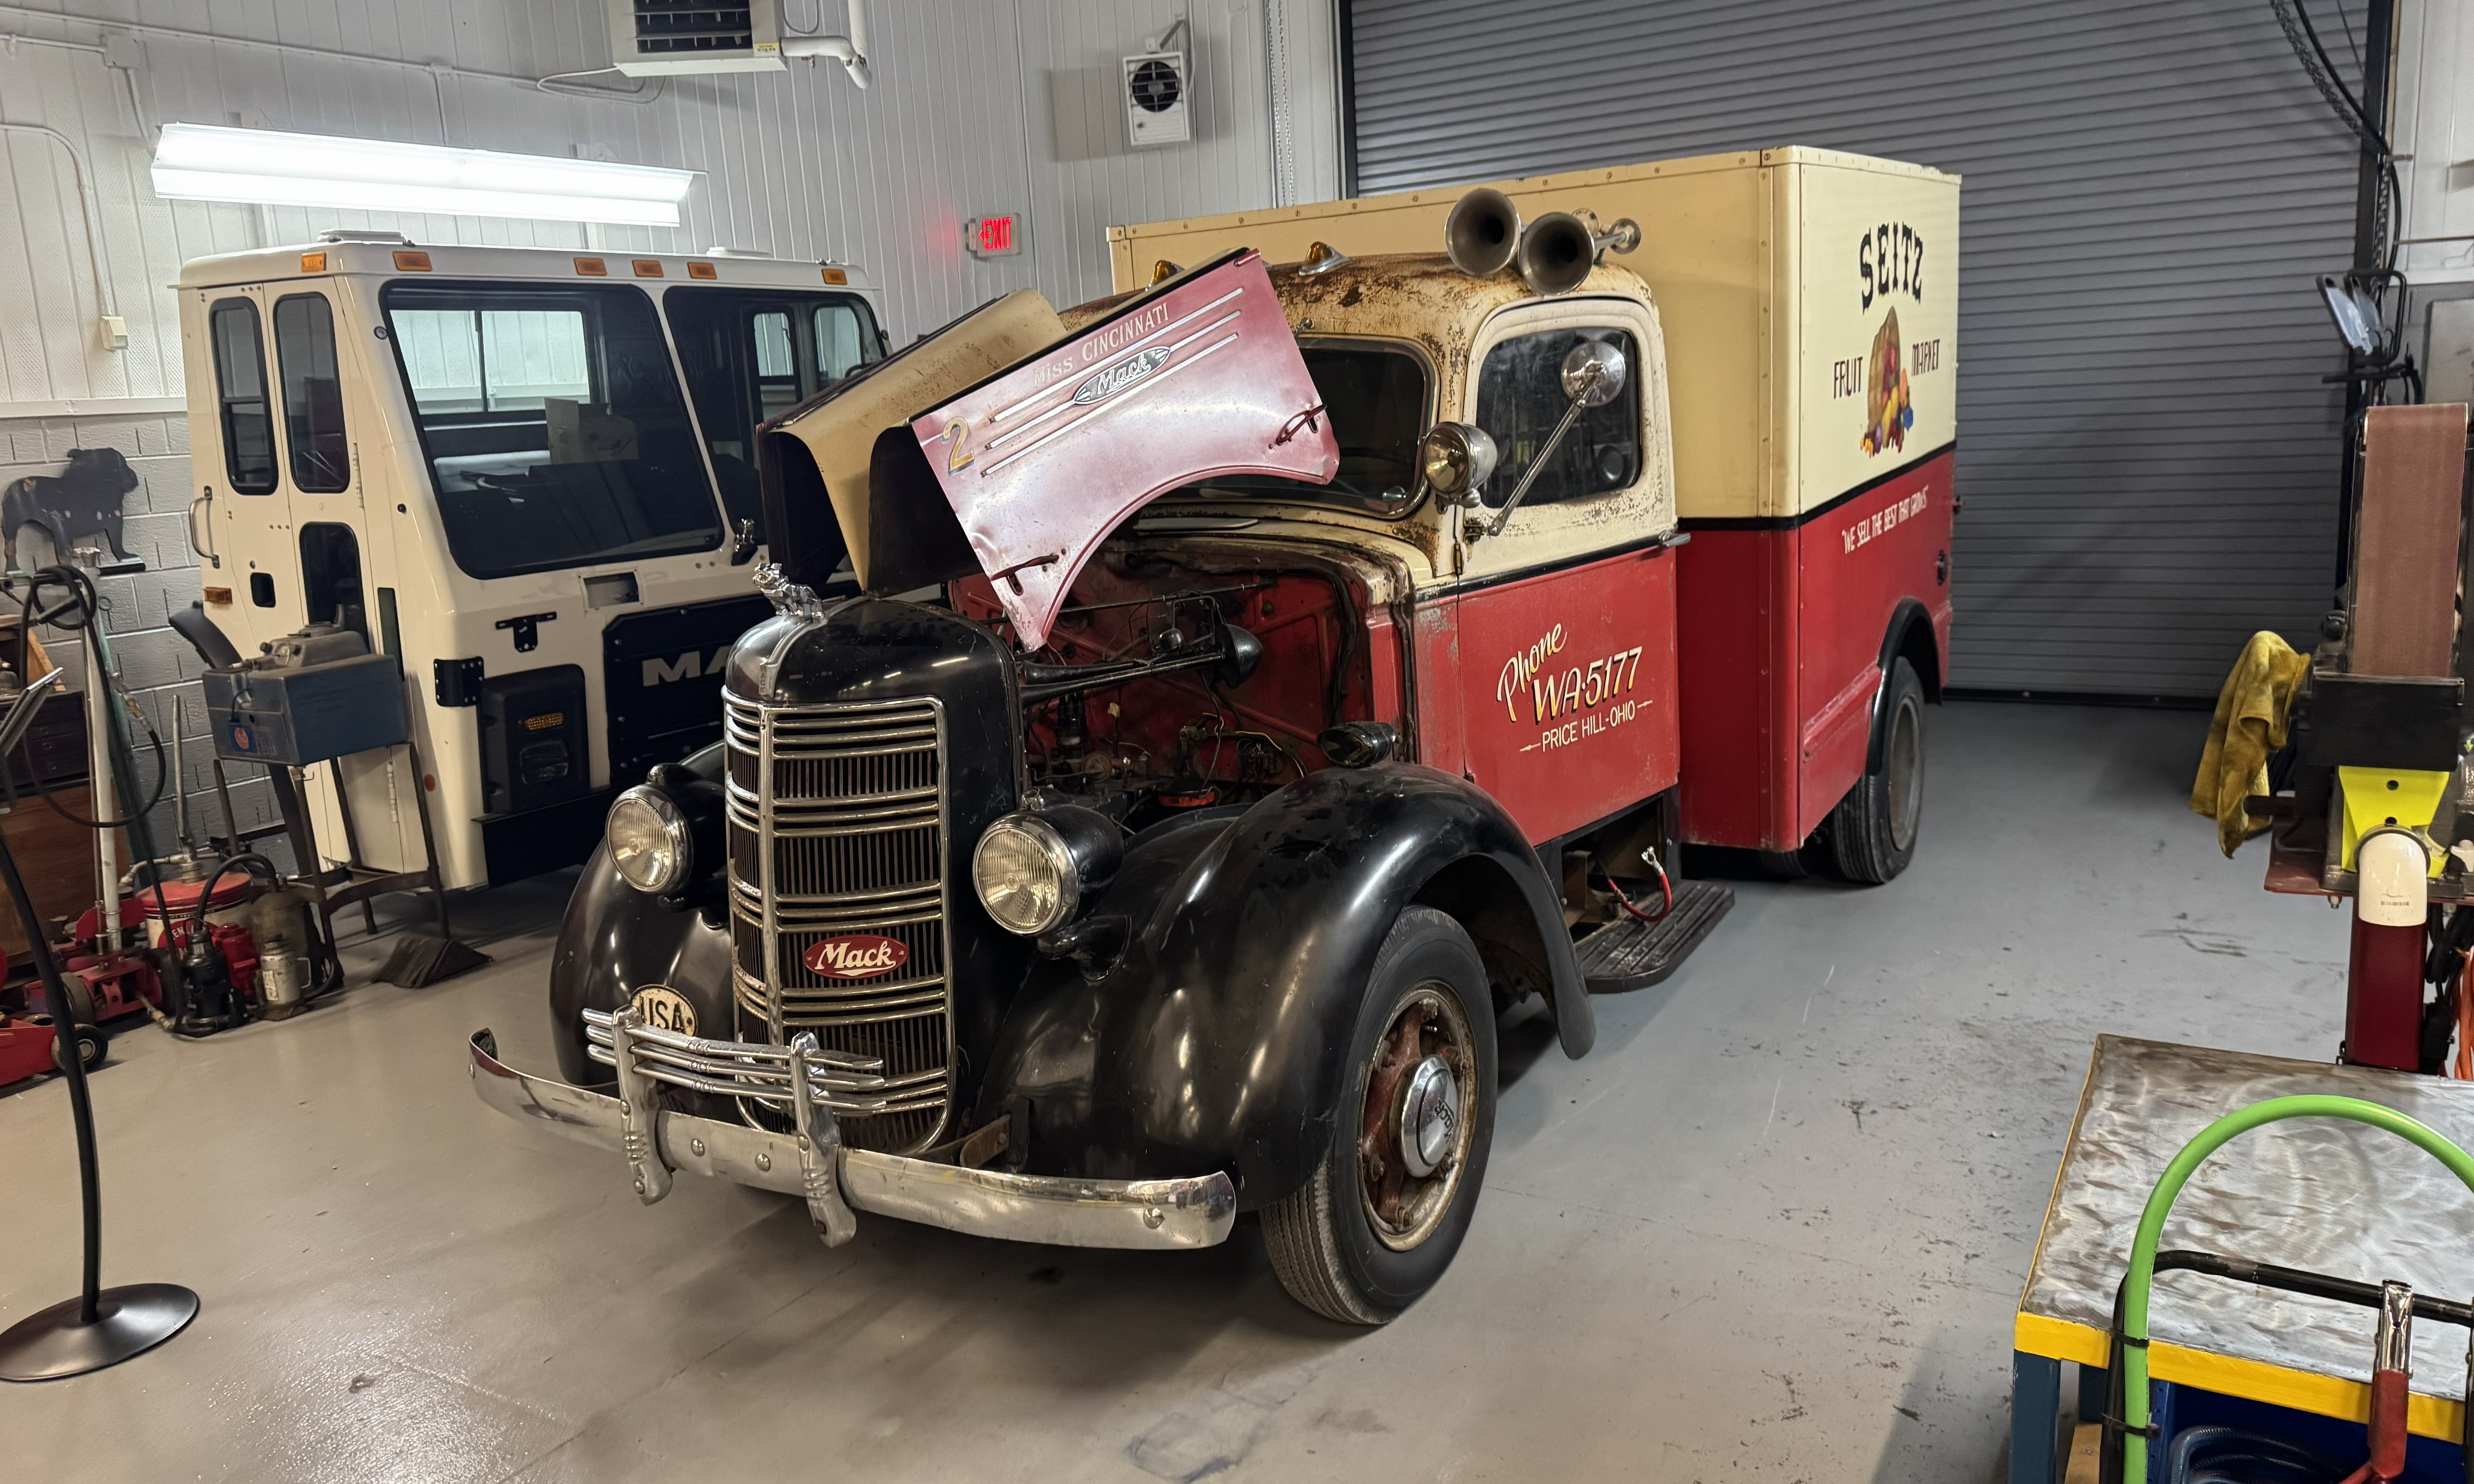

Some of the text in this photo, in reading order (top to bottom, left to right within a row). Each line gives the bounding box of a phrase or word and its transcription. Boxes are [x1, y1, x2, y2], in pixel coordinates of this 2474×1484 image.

[983, 217, 1012, 250] EXIT
[1859, 221, 1923, 315] SEITZ
[1082, 303, 1169, 362] CINCINNATI
[1097, 352, 1152, 395] Mack
[1834, 356, 1863, 399] FRUIT
[942, 416, 975, 474] 2
[1857, 518, 1871, 547] SELL
[1872, 512, 1883, 538] THE
[1884, 503, 1898, 532] BEST
[1497, 623, 1568, 723] Phone
[1542, 721, 1578, 752] PRICE
[814, 940, 896, 976] Mack
[640, 996, 687, 1035] USA
